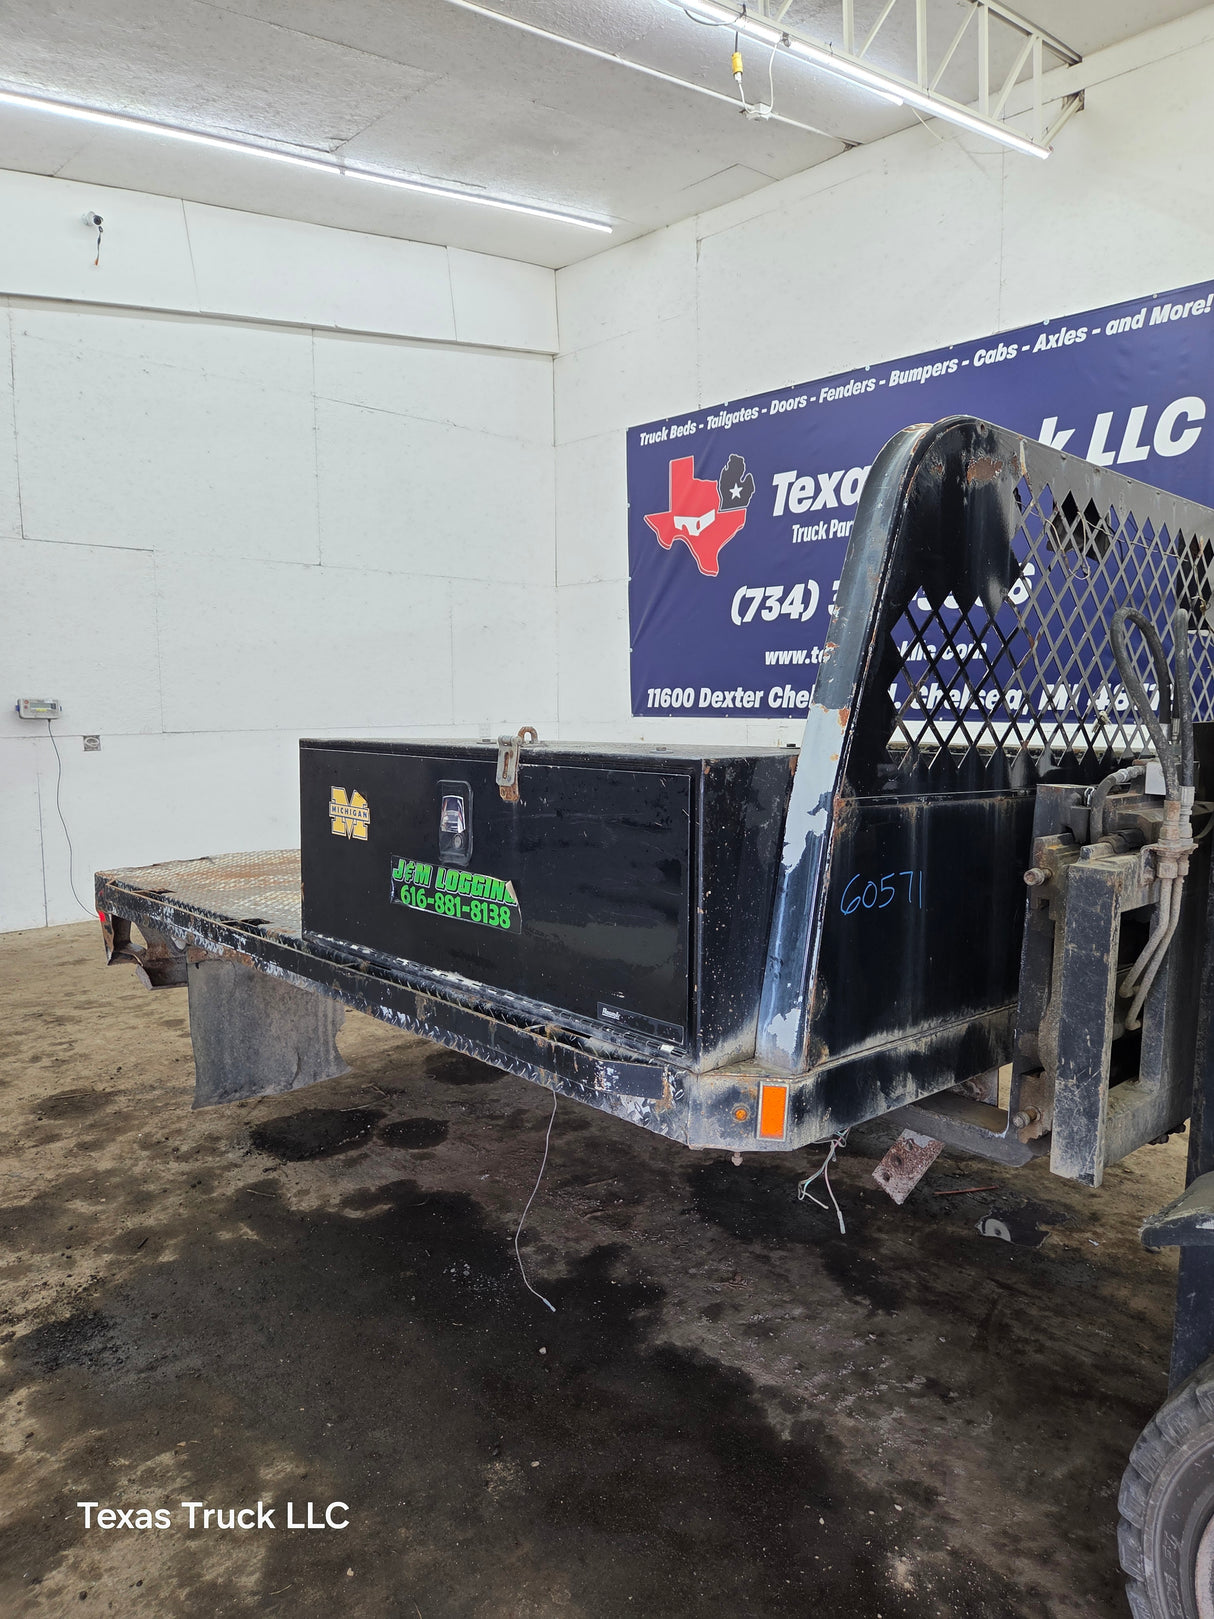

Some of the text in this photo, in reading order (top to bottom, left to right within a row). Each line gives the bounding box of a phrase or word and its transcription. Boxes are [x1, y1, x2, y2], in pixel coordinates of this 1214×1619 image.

[639, 427, 668, 446] Truck
[670, 421, 696, 439] Beds
[706, 405, 759, 430] Tailgates
[769, 395, 807, 416] Doors
[818, 377, 876, 403] Fenders
[888, 358, 959, 387] Bumpers
[973, 344, 1017, 368] Cabs
[1032, 326, 1088, 353] Axles
[1105, 308, 1147, 336] and
[1149, 293, 1214, 326] More!
[772, 464, 872, 517] Texa
[1085, 396, 1207, 467] LLC
[792, 521, 827, 543] Truck
[731, 579, 820, 626] (734)
[647, 687, 695, 708] 11600
[699, 687, 764, 708] Dexter
[331, 805, 368, 818] MICHIGAN
[400, 884, 511, 929] 616-881-8138
[840, 870, 923, 915] 60571
